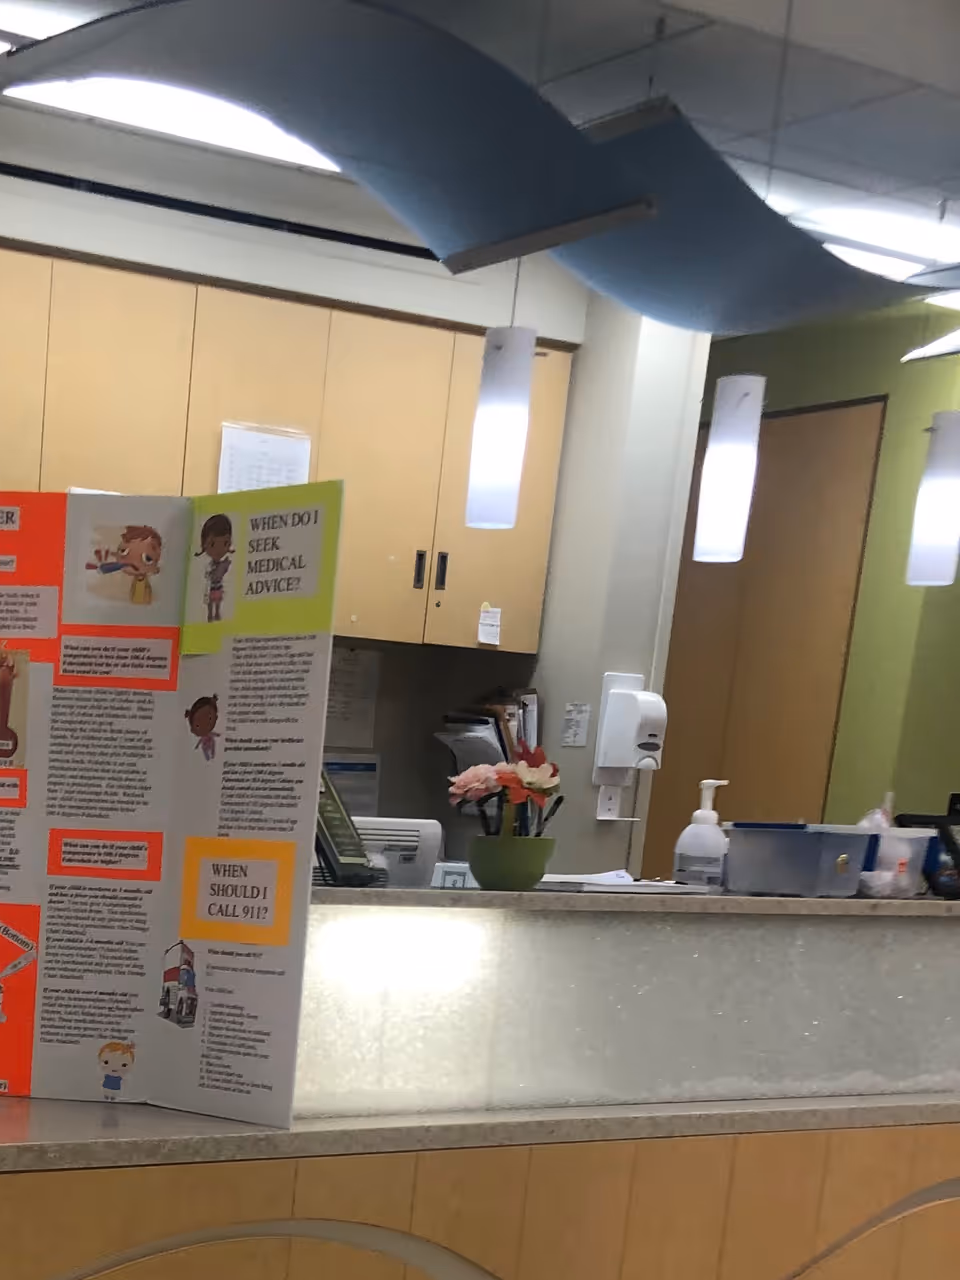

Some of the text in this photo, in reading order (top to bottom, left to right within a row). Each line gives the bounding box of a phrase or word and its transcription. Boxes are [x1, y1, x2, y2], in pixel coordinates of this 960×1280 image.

[250, 509, 319, 531] WHEN DO I
[248, 536, 280, 554] SEEK
[247, 554, 306, 575] MEDICAL
[245, 577, 301, 595] ADVICE?
[211, 863, 248, 878] WHEN
[209, 883, 268, 899] SHOULD I
[207, 903, 268, 919] CALL 911?
